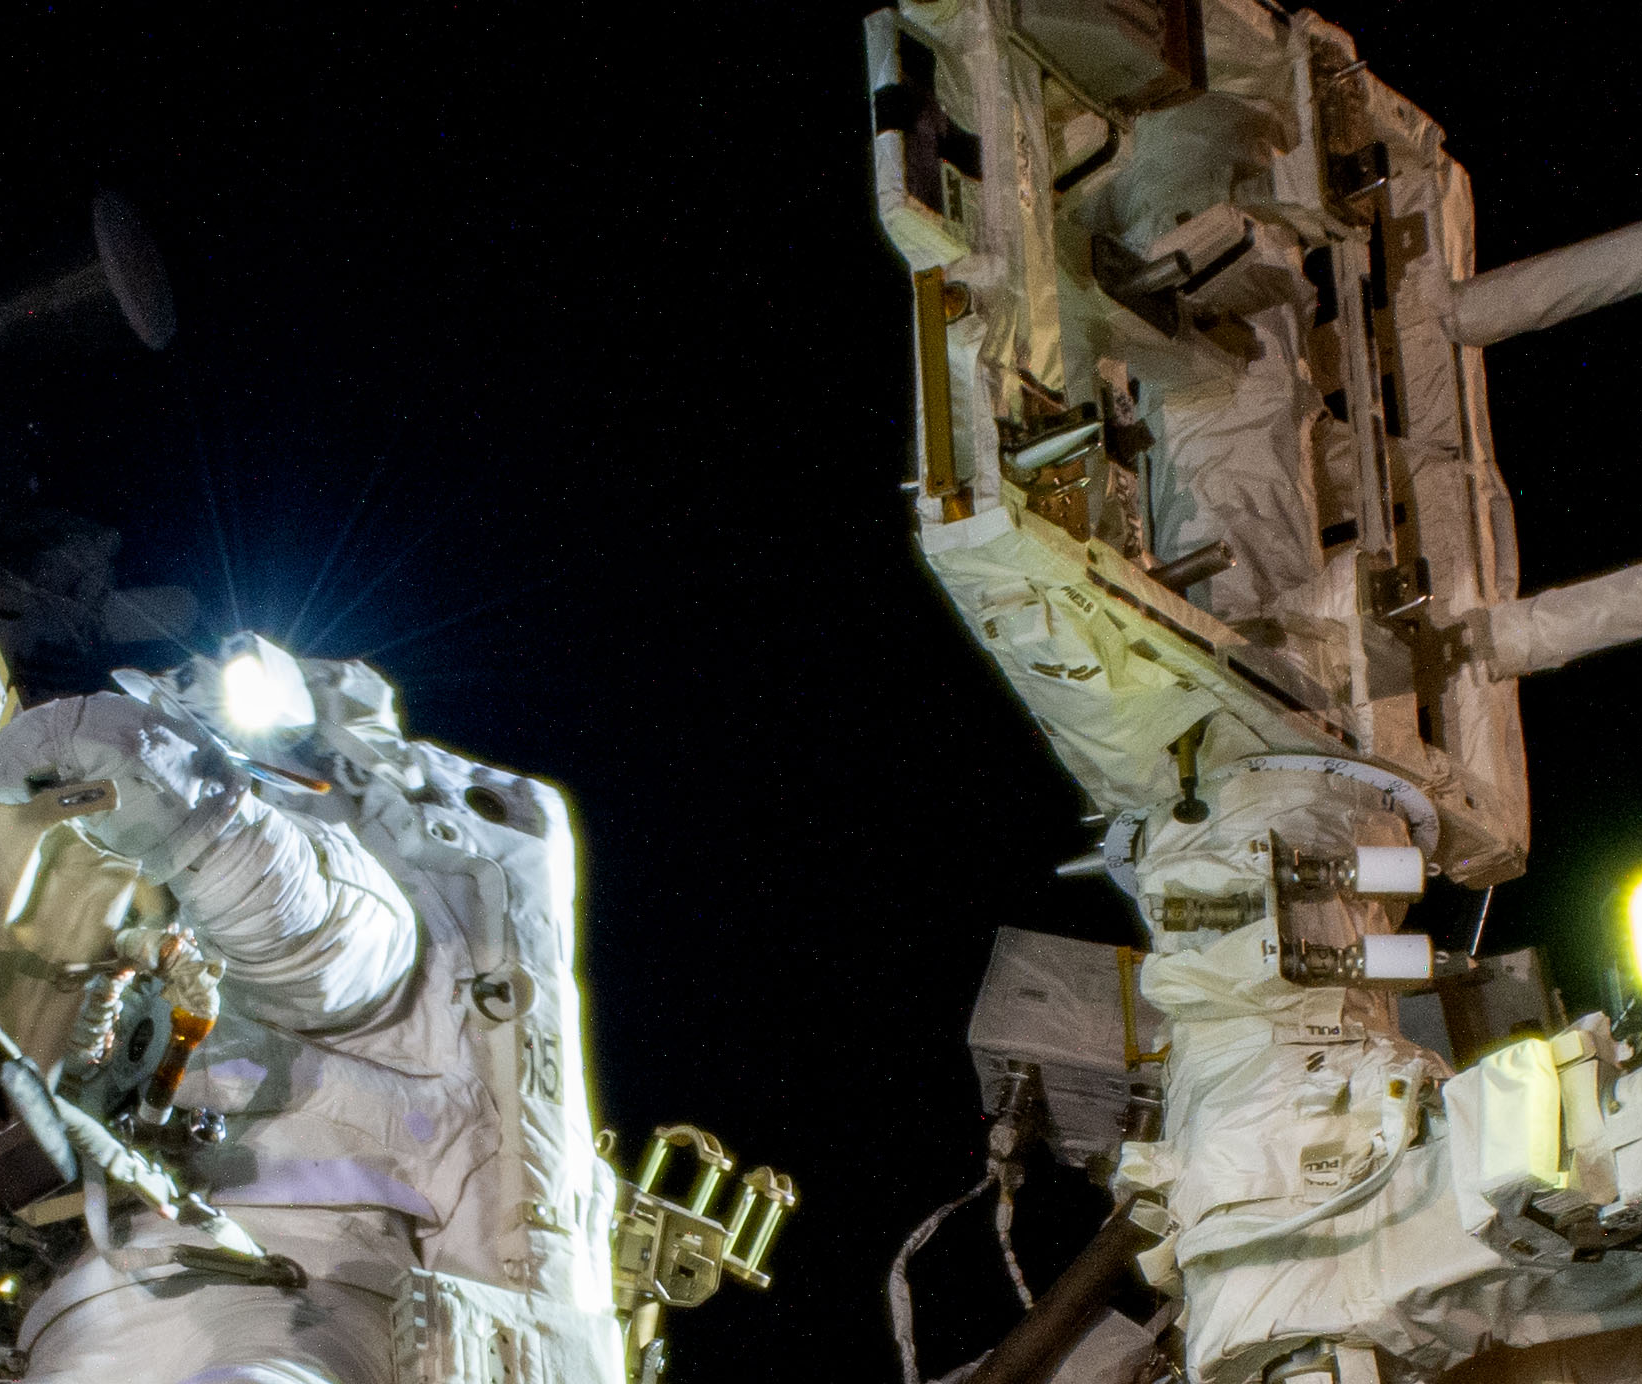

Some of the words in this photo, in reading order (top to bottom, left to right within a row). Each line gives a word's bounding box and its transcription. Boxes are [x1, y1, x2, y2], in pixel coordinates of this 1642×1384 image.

[1305, 1024, 1341, 1036] PULL
[524, 1034, 558, 1100] 15
[1304, 1159, 1339, 1172] PULL
